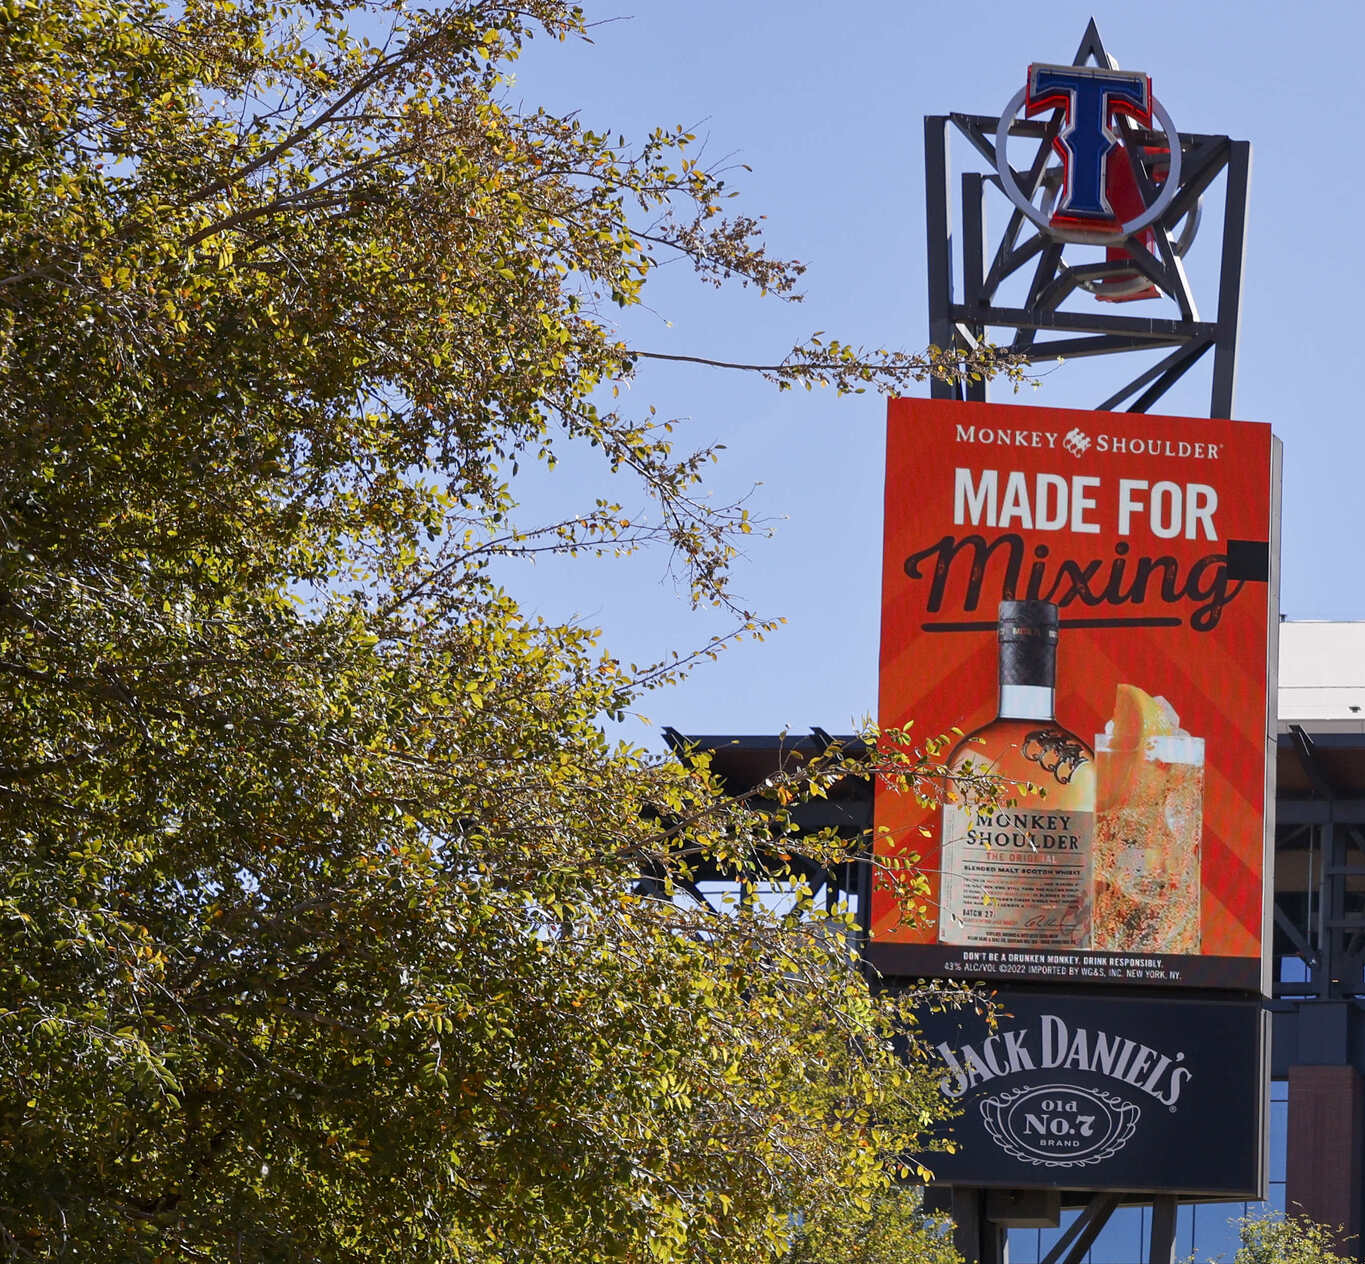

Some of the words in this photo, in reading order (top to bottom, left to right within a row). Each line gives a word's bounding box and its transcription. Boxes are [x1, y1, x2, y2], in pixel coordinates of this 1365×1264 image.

[956, 424, 1058, 448] MONKEY
[1096, 434, 1219, 459] SHOULDER
[954, 467, 1101, 534] MADE
[1118, 478, 1218, 541] FOR
[904, 533, 1245, 632] Mixing
[976, 814, 1071, 830] MONKEY
[967, 830, 1080, 849] SHOULDER
[997, 867, 1019, 875] MALT
[963, 951, 987, 961] DON'T
[988, 952, 999, 962] BE
[1001, 953, 1008, 962] A
[1008, 953, 1045, 963] DRUNKEN
[1083, 956, 1107, 966] DRINK
[1028, 965, 1066, 975] IMPORTED
[1069, 967, 1080, 976] BY
[1126, 969, 1143, 978] NEW
[937, 1028, 1032, 1098] JACK
[1040, 1014, 1192, 1106] DANIEL'S
[1041, 1100, 1077, 1113] Old
